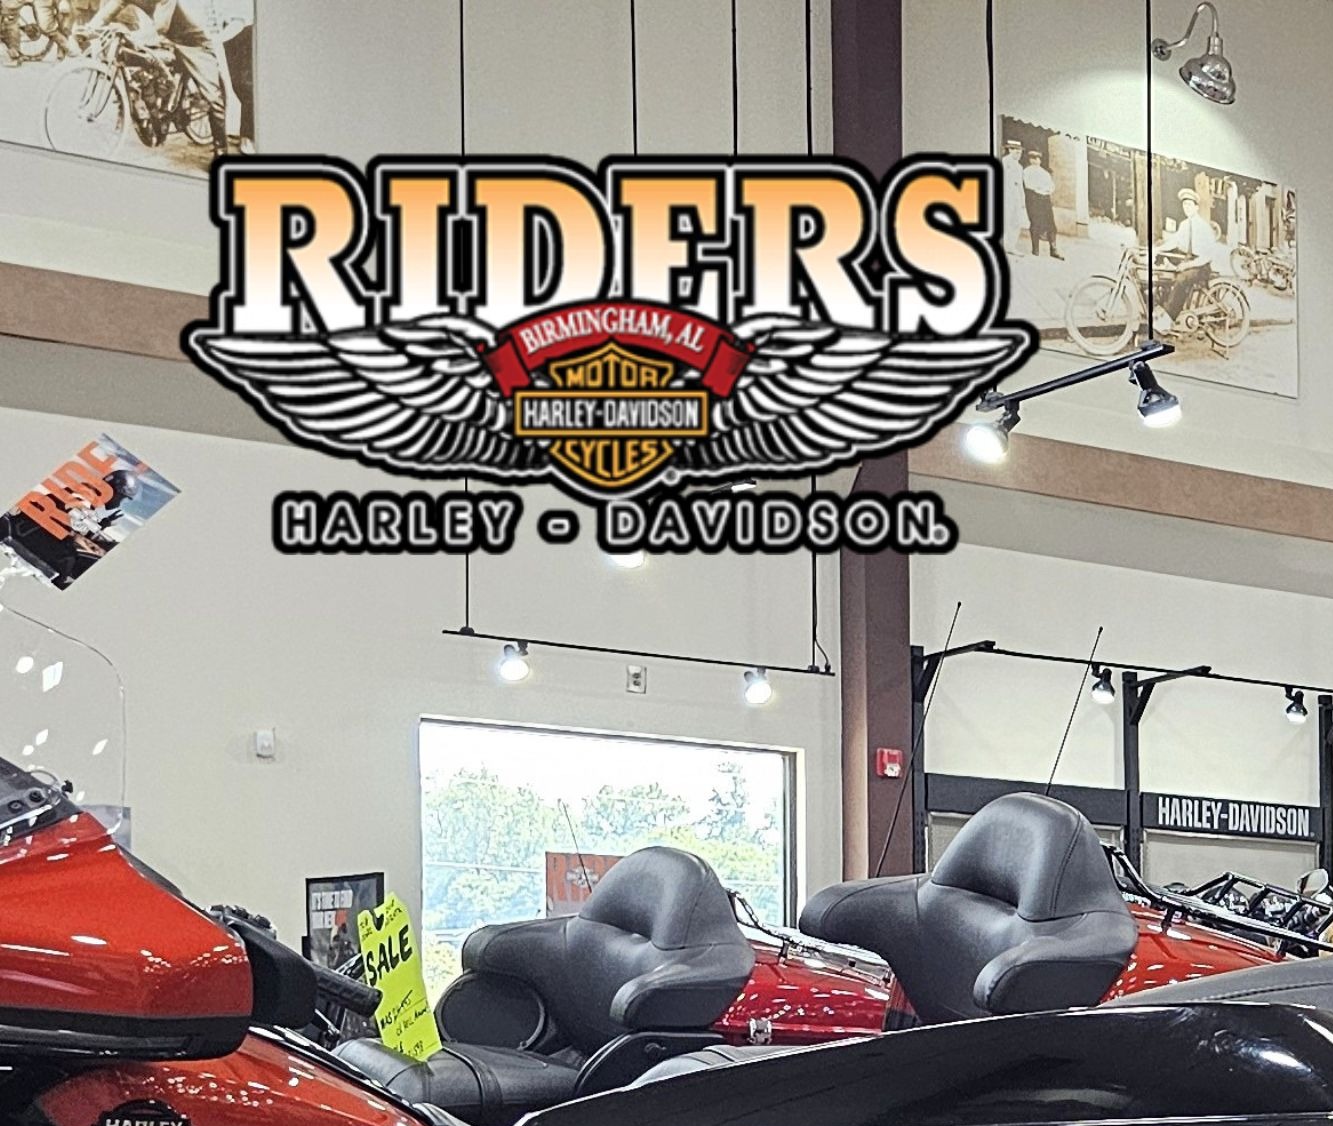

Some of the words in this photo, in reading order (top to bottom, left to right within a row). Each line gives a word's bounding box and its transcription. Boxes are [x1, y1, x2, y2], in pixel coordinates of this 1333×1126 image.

[17, 439, 119, 541] RIDE
[1157, 796, 1310, 837] HARLEY-DAVIDSON
[365, 923, 413, 987] SALE
